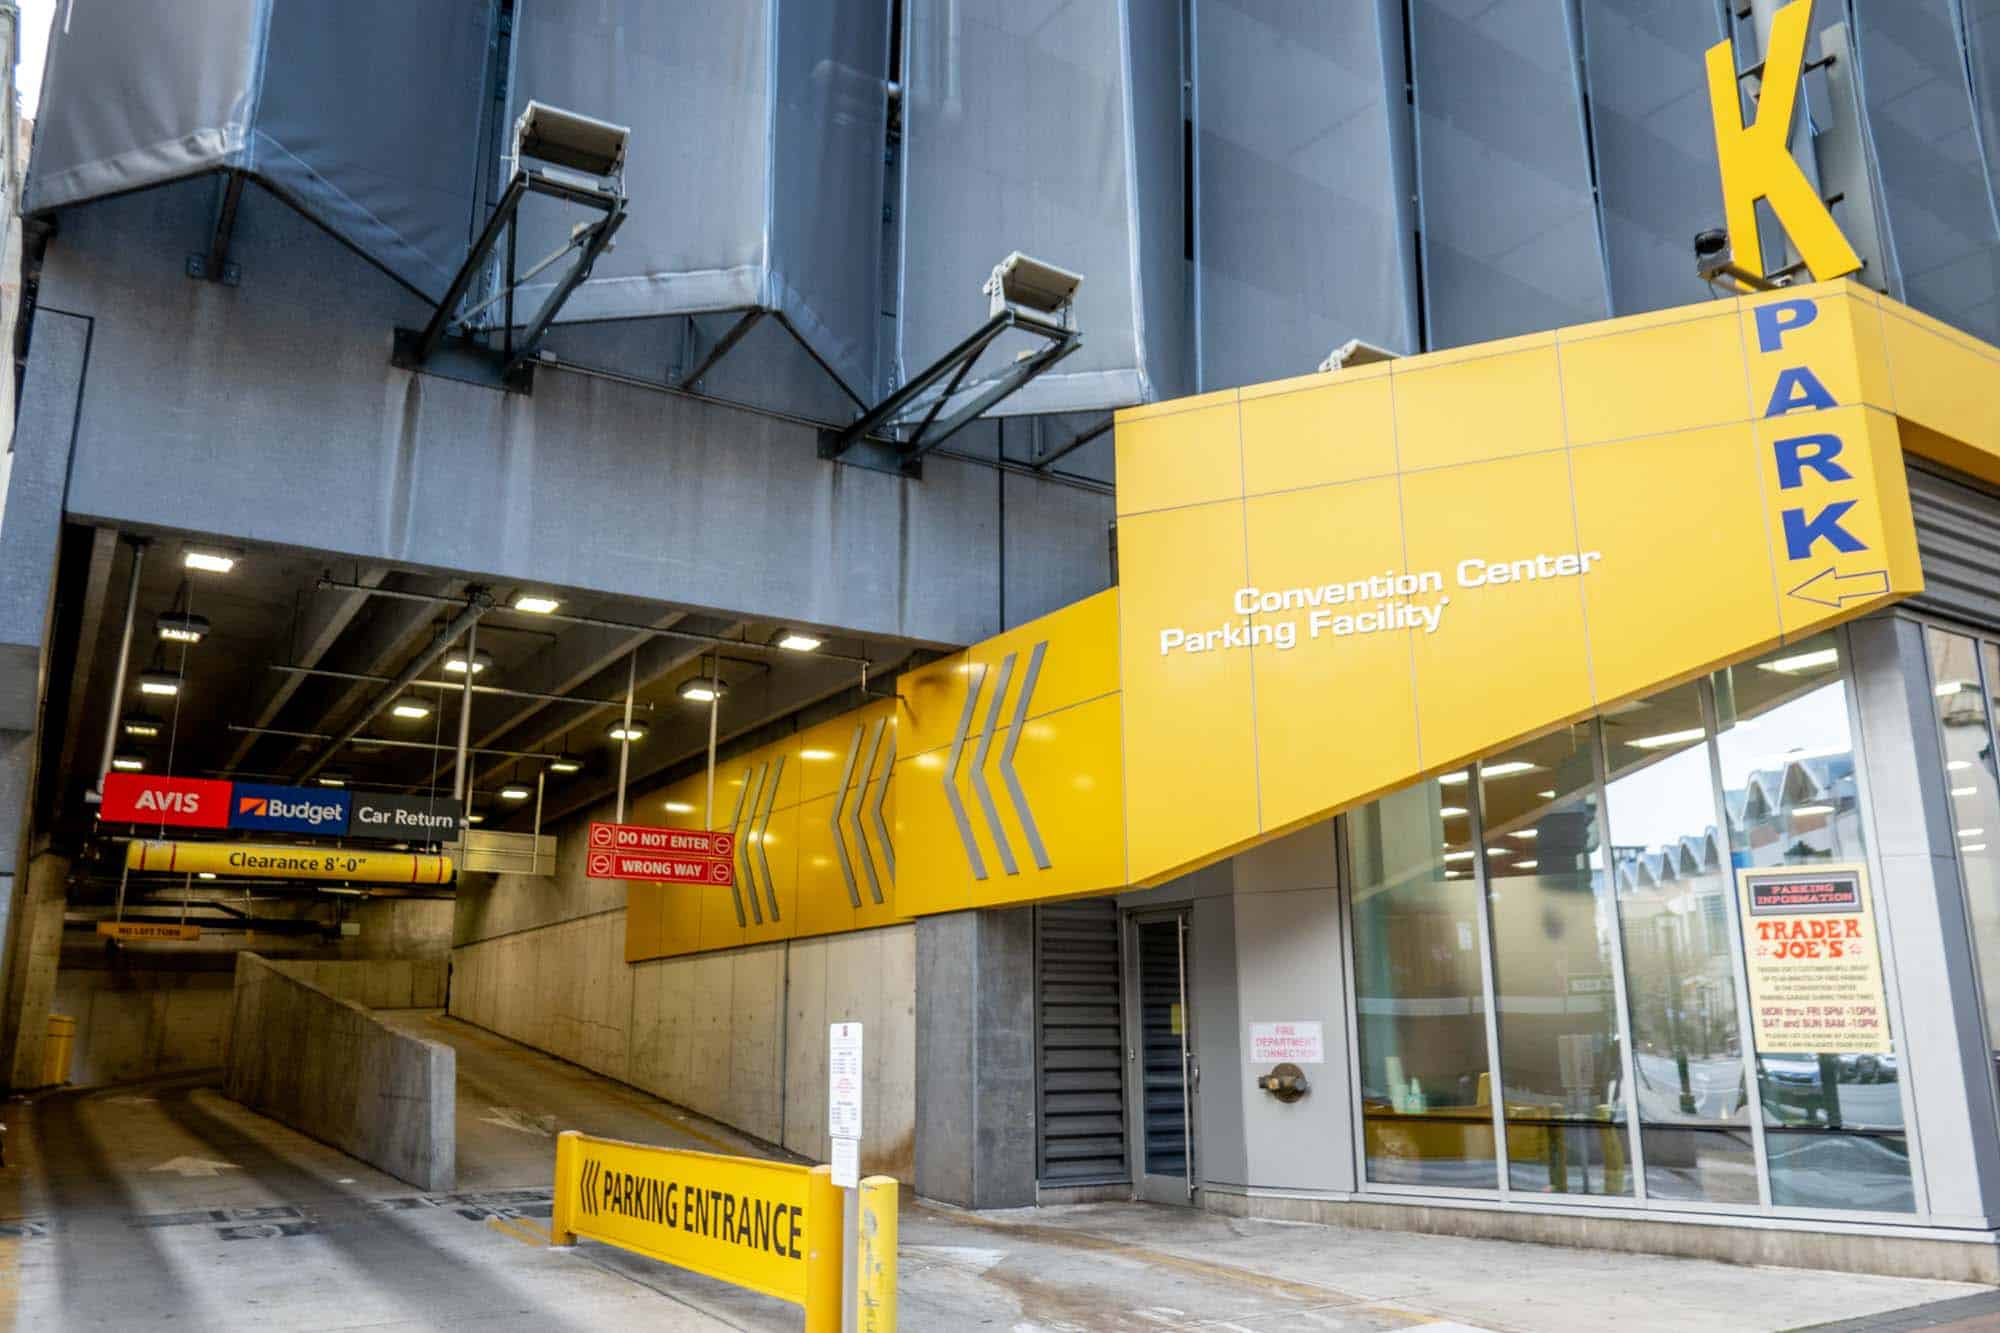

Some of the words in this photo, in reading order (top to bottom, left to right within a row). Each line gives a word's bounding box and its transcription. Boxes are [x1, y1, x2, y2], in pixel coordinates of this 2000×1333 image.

[1754, 298, 1870, 561] PARK
[1233, 569, 1444, 617] Convention
[1456, 550, 1602, 588] Center
[1159, 619, 1297, 656] Parking
[1309, 596, 1451, 640] Facility
[135, 789, 200, 814] AVIS
[268, 799, 344, 825] Budget
[358, 806, 391, 824] Car
[395, 809, 454, 828] Return
[618, 831, 638, 845] DO
[641, 833, 668, 847] NOT
[670, 835, 709, 850] ENTER
[229, 852, 320, 872] Clearance
[324, 857, 367, 873] 8'-0"
[621, 860, 671, 875] WRONG
[673, 864, 702, 877] WAY
[1757, 893, 1853, 905] INFORMATION
[1771, 884, 1834, 894] PARKING
[1756, 919, 1862, 941] TRADER
[1773, 939, 1844, 959] JOE'S
[603, 1170, 677, 1228] PARKING
[683, 1185, 803, 1260] ENTRANCE
